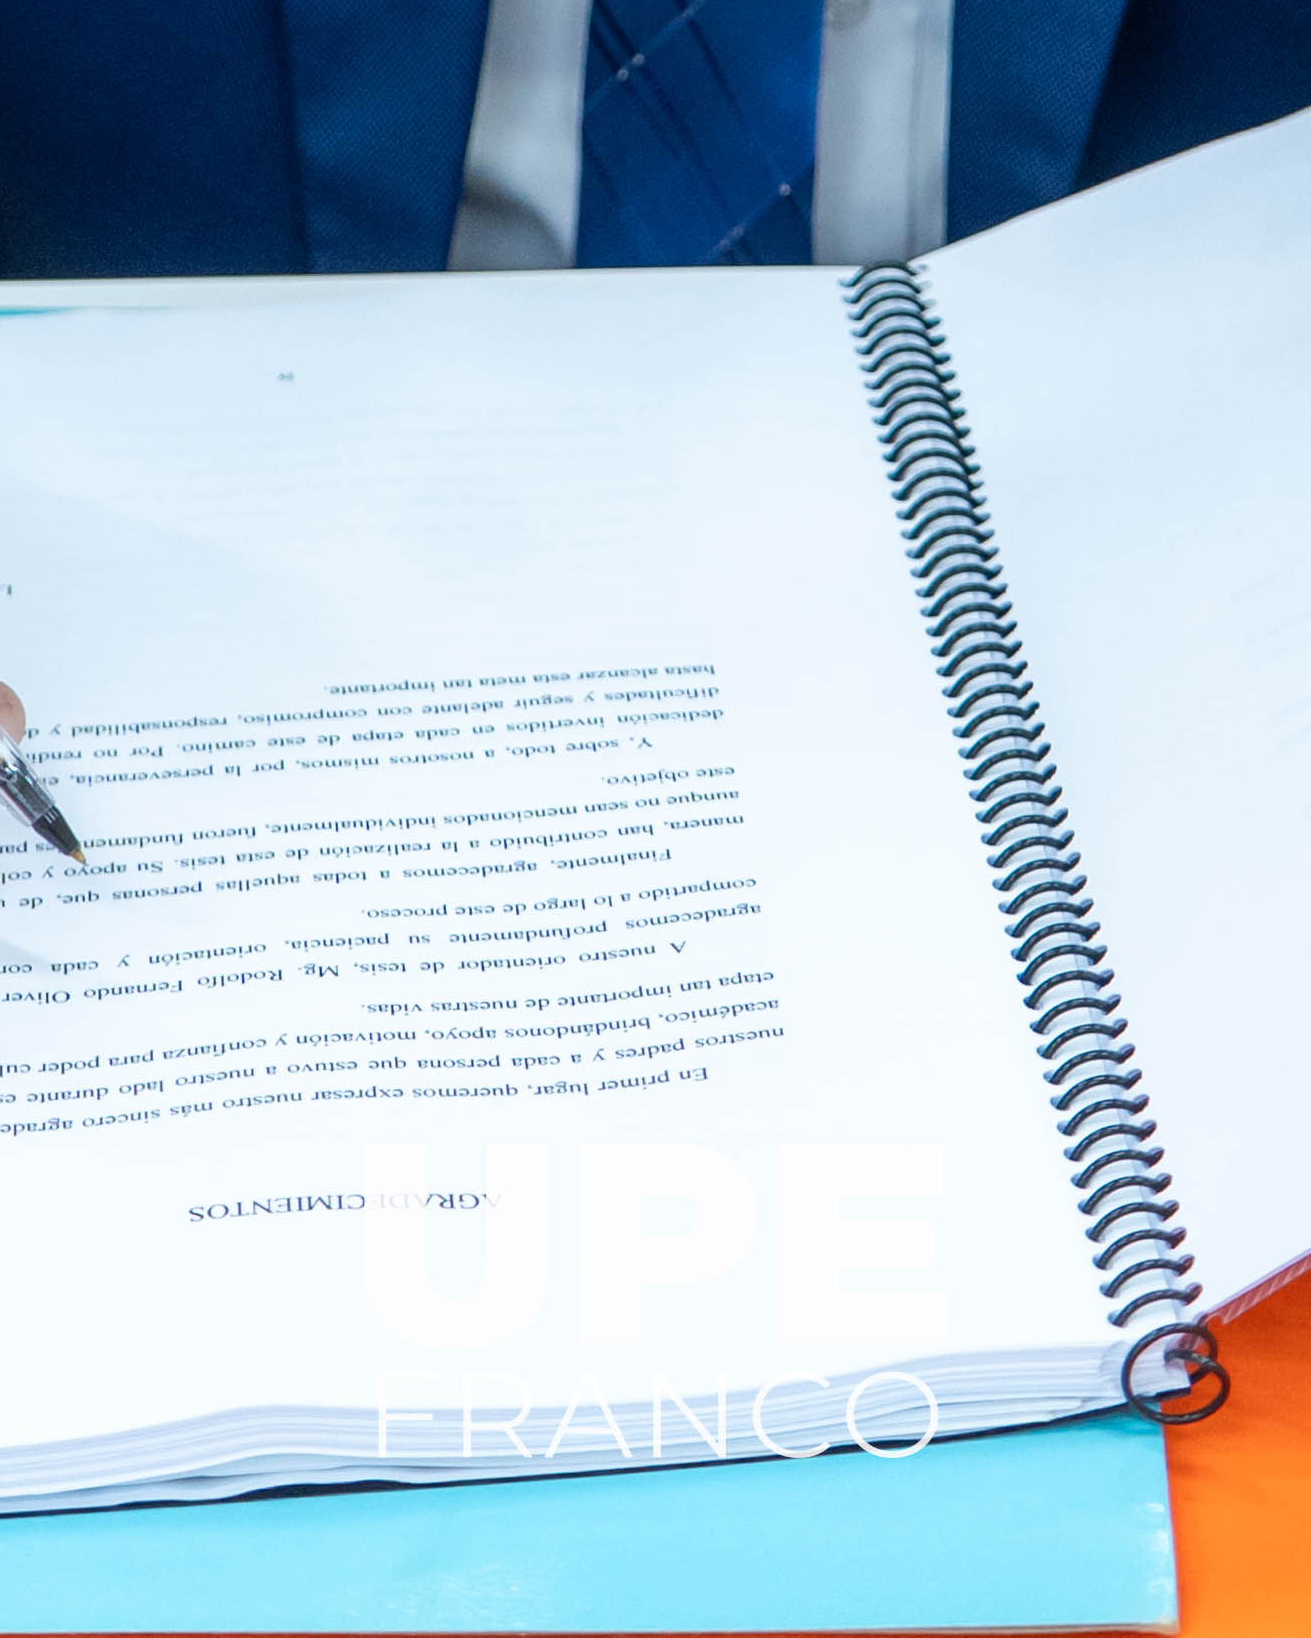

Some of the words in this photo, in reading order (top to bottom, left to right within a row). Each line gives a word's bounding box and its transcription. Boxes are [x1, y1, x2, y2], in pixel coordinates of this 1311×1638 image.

[577, 667, 658, 680] alcanzar
[664, 664, 716, 676] hasta
[442, 679, 473, 689] tan
[478, 675, 527, 687] meta
[532, 672, 571, 684] esta
[323, 679, 435, 696] importante.
[604, 686, 720, 703] dificultades
[514, 694, 574, 710] seguir
[584, 690, 595, 702] y
[376, 704, 414, 718] con
[420, 699, 504, 716] adelante
[237, 708, 368, 726] compromiso,
[617, 708, 724, 725] dedicación
[50, 723, 61, 736] y
[71, 715, 228, 738] responsabilidad
[471, 724, 496, 735] en
[506, 716, 605, 733] invertidos
[316, 734, 341, 747] de
[351, 729, 405, 742] etapa
[414, 727, 461, 741] cada
[175, 739, 257, 754] camino.
[267, 736, 306, 748] este
[565, 740, 619, 753] sobre
[629, 737, 653, 749] Y,
[93, 748, 118, 758] no
[130, 745, 164, 758] Por
[389, 751, 475, 765] nosotros
[484, 749, 495, 759] a
[505, 744, 556, 759] todo,
[252, 758, 285, 773] por
[295, 756, 380, 770] mismos,
[68, 763, 215, 788] perseverancia,
[224, 764, 241, 778] la
[601, 769, 690, 787] objetivo.
[696, 766, 736, 778] este
[632, 796, 662, 810] no
[666, 790, 739, 805] aunque
[582, 799, 630, 814] sean
[443, 805, 578, 827] mencionados
[663, 815, 745, 830] manera,
[265, 816, 436, 834] individualmente,
[617, 823, 654, 837] han
[192, 826, 257, 841] fueron
[489, 829, 608, 851] contribuido
[34, 832, 184, 855] fundamenes
[319, 842, 432, 859] realización
[441, 841, 459, 853] la
[468, 839, 480, 849] a
[235, 850, 276, 863] esta
[285, 848, 310, 861] de
[550, 848, 672, 870] Finalmente,
[62, 859, 129, 878] apoyo
[137, 861, 164, 874] Su
[174, 854, 226, 871] tesis.
[402, 859, 538, 879] agradecemos
[39, 864, 55, 880] y
[312, 870, 367, 885] todas
[379, 869, 391, 879] a
[215, 872, 300, 893] aquellas
[638, 878, 757, 902] compartido
[56, 889, 100, 905] que,
[111, 880, 203, 901] personas
[619, 892, 631, 903] a
[18, 896, 44, 910] de
[533, 897, 587, 912] largo
[593, 894, 614, 908] lo
[361, 903, 448, 919] proceso.
[454, 904, 496, 917] este
[502, 903, 527, 917] de
[625, 902, 762, 930] agradecemos
[408, 934, 431, 945] su
[449, 919, 608, 945] profundamente
[284, 932, 390, 953] paciencia,
[669, 940, 687, 954] A
[117, 954, 131, 968] y
[148, 943, 267, 967] orientación
[578, 944, 656, 963] nuestro
[50, 960, 99, 976] cada
[297, 962, 340, 978] Mg.
[353, 962, 407, 976] tesis,
[419, 961, 445, 975] de
[457, 955, 567, 973] orientador
[197, 968, 283, 989] Rodolfo
[679, 979, 712, 993] tan
[717, 971, 775, 987] etapa
[1, 990, 71, 1005] Oliver
[83, 979, 183, 1001] Fernando
[557, 984, 672, 1007] importante
[359, 1003, 423, 1017] vidas.
[430, 999, 518, 1013] nuestras
[524, 997, 551, 1012] de
[658, 999, 779, 1024] académico,
[424, 1025, 497, 1040] apoyo,
[504, 1016, 651, 1040] brindándonos
[274, 1033, 288, 1047] y
[295, 1030, 417, 1048] motivación
[694, 1027, 785, 1048] nuestros
[162, 1038, 268, 1060] confianza
[592, 1047, 606, 1062] y
[614, 1037, 686, 1060] padres
[37, 1054, 100, 1076] poder
[108, 1049, 155, 1067] para
[368, 1055, 407, 1070] que
[416, 1054, 501, 1069] persona
[510, 1055, 561, 1071] cada
[570, 1053, 582, 1064] a
[265, 1065, 277, 1076] a
[286, 1060, 358, 1074] estuvo
[678, 1067, 709, 1082] En
[174, 1067, 256, 1087] nuestro
[597, 1069, 671, 1091] primer
[26, 1087, 109, 1104] durante
[118, 1079, 164, 1097] lado
[310, 1085, 405, 1101] expresar
[411, 1083, 519, 1098] queremos
[527, 1080, 589, 1097] lugar,
[222, 1091, 303, 1109] nuestro
[169, 1101, 214, 1118] más
[81, 1108, 161, 1128] sincero
